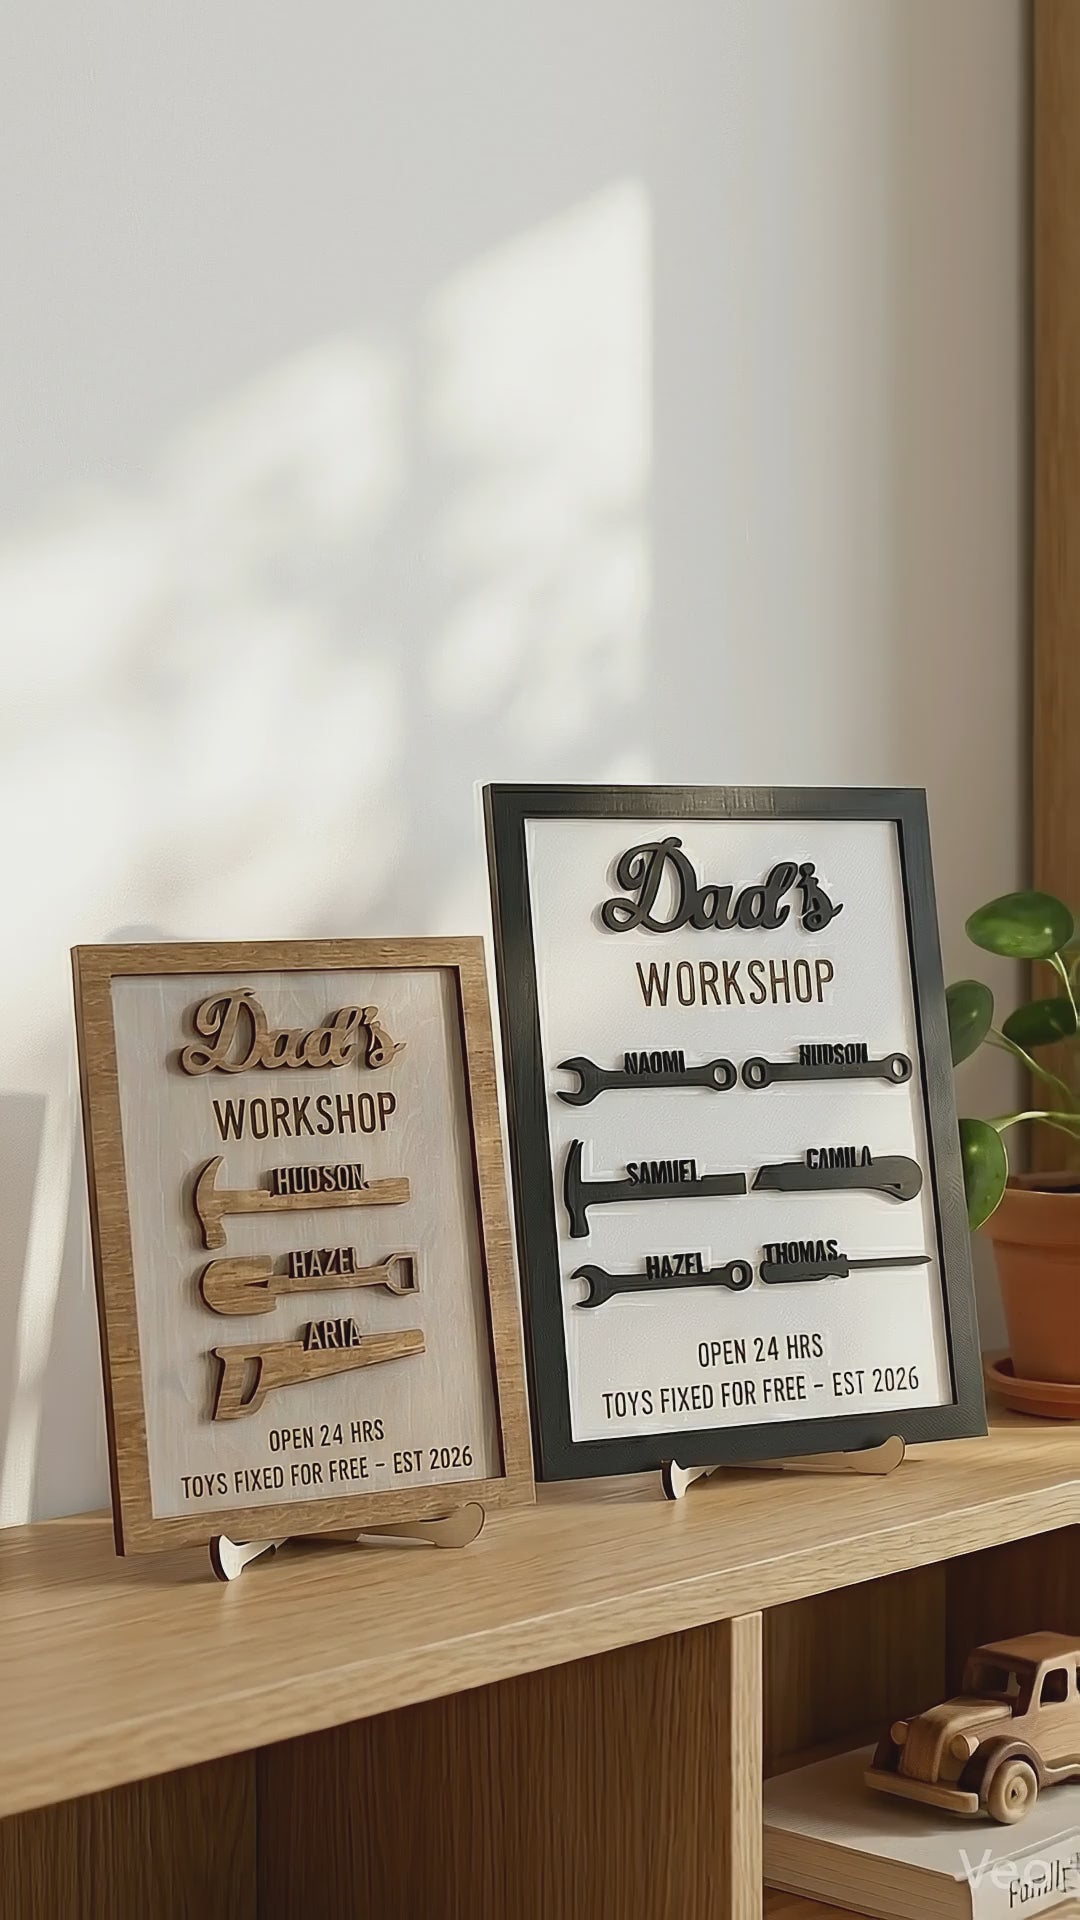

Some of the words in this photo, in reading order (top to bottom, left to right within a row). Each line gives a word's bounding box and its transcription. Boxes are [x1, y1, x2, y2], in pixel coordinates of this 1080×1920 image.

[601, 837, 843, 932] Dad's
[636, 959, 834, 1007] WORKSHOP
[179, 987, 407, 1076] Dad's
[624, 1050, 686, 1075] NAOMI
[213, 1092, 397, 1141] WORKSHOP
[275, 1163, 365, 1195] HUDSON
[290, 1247, 358, 1278] HAZEL
[645, 1252, 704, 1280] HAZEL
[762, 1240, 841, 1265] THOMAS
[304, 1317, 362, 1350] ARIA
[699, 1339, 746, 1367] OPEN
[754, 1336, 779, 1362] 24
[786, 1333, 823, 1359] HRS
[602, 1390, 653, 1419] TOYS
[660, 1384, 713, 1413] FIXED
[721, 1380, 756, 1407] FOR
[763, 1376, 806, 1403] FREE
[833, 1371, 864, 1396] EST
[872, 1366, 919, 1393] 2026
[269, 1426, 314, 1452] OPEN
[320, 1423, 343, 1447] 24
[350, 1419, 385, 1443] HRS
[181, 1473, 228, 1499] TOYS
[234, 1466, 284, 1493] FIXED
[291, 1462, 322, 1486] FOR
[329, 1457, 369, 1482] FREE
[393, 1451, 423, 1474] EST
[429, 1446, 473, 1470] 2026
